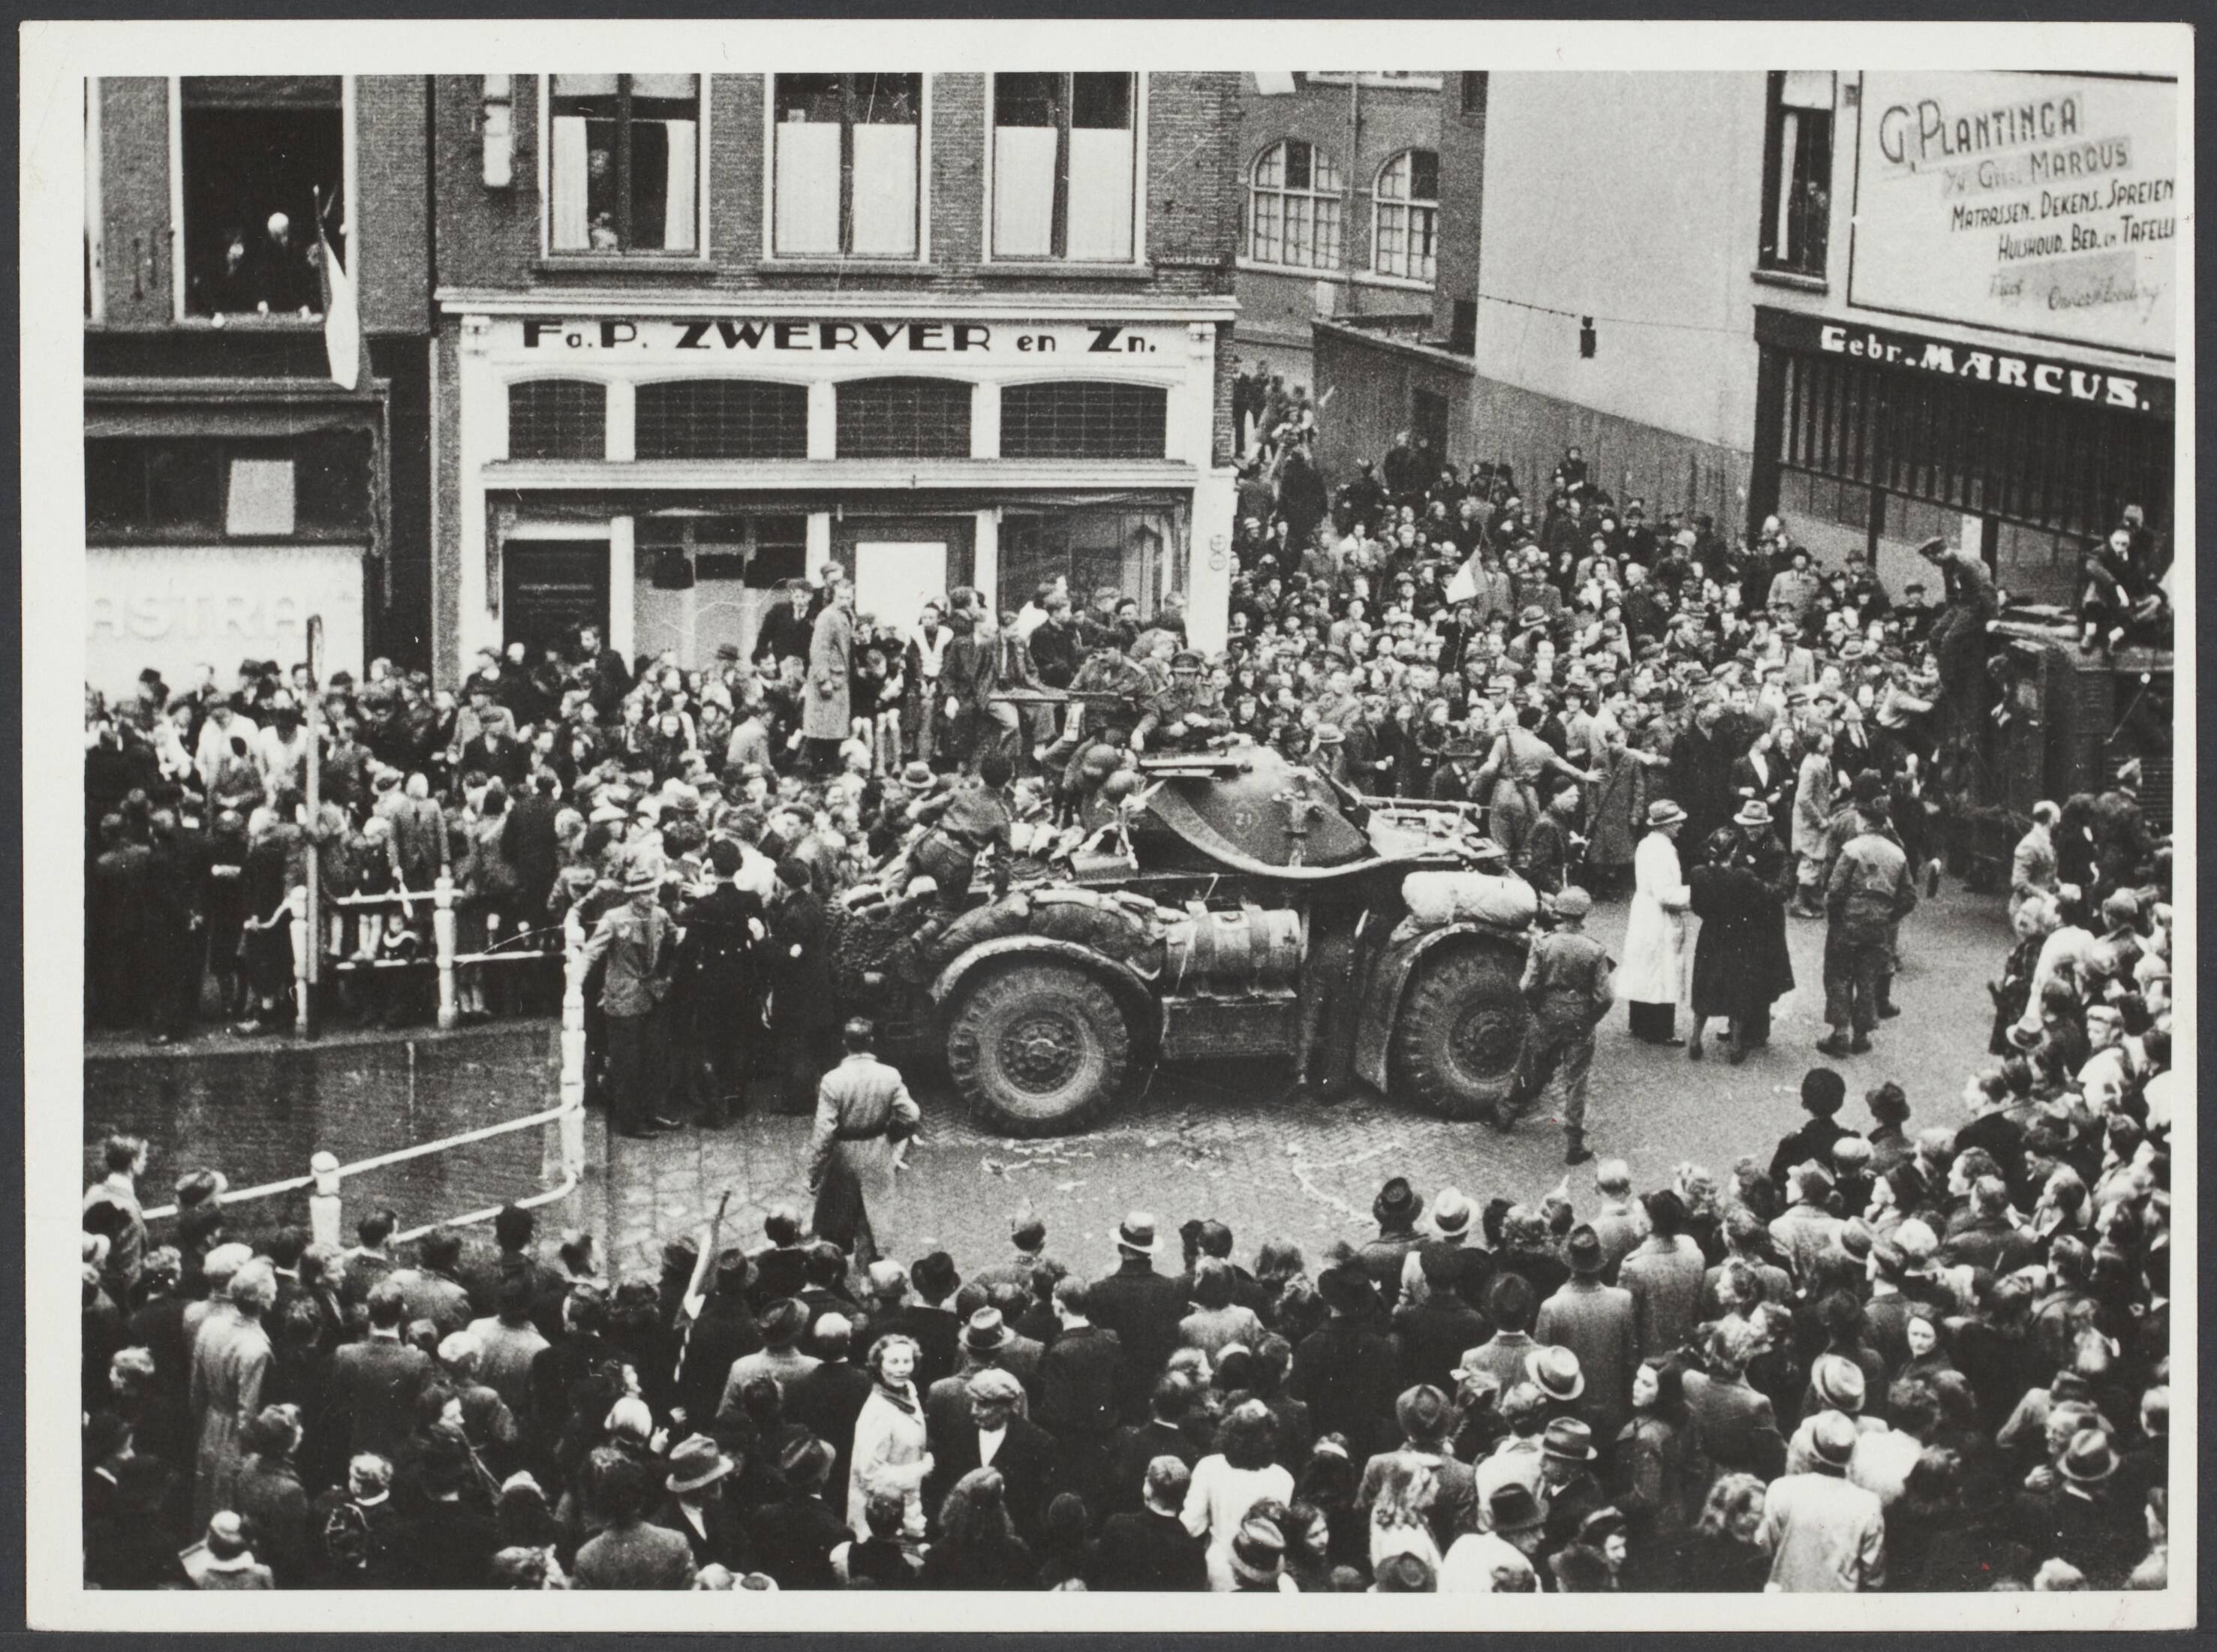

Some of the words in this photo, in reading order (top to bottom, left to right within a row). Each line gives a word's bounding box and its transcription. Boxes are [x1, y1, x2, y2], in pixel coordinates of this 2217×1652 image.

[1918, 98, 2077, 159] PLANTINGA
[2106, 179, 2175, 209] SPREIEN
[672, 320, 991, 351] ZWERVER
[1016, 334, 1057, 351] en
[1087, 325, 1157, 353] Zn.
[86, 595, 306, 642] ASTRA
